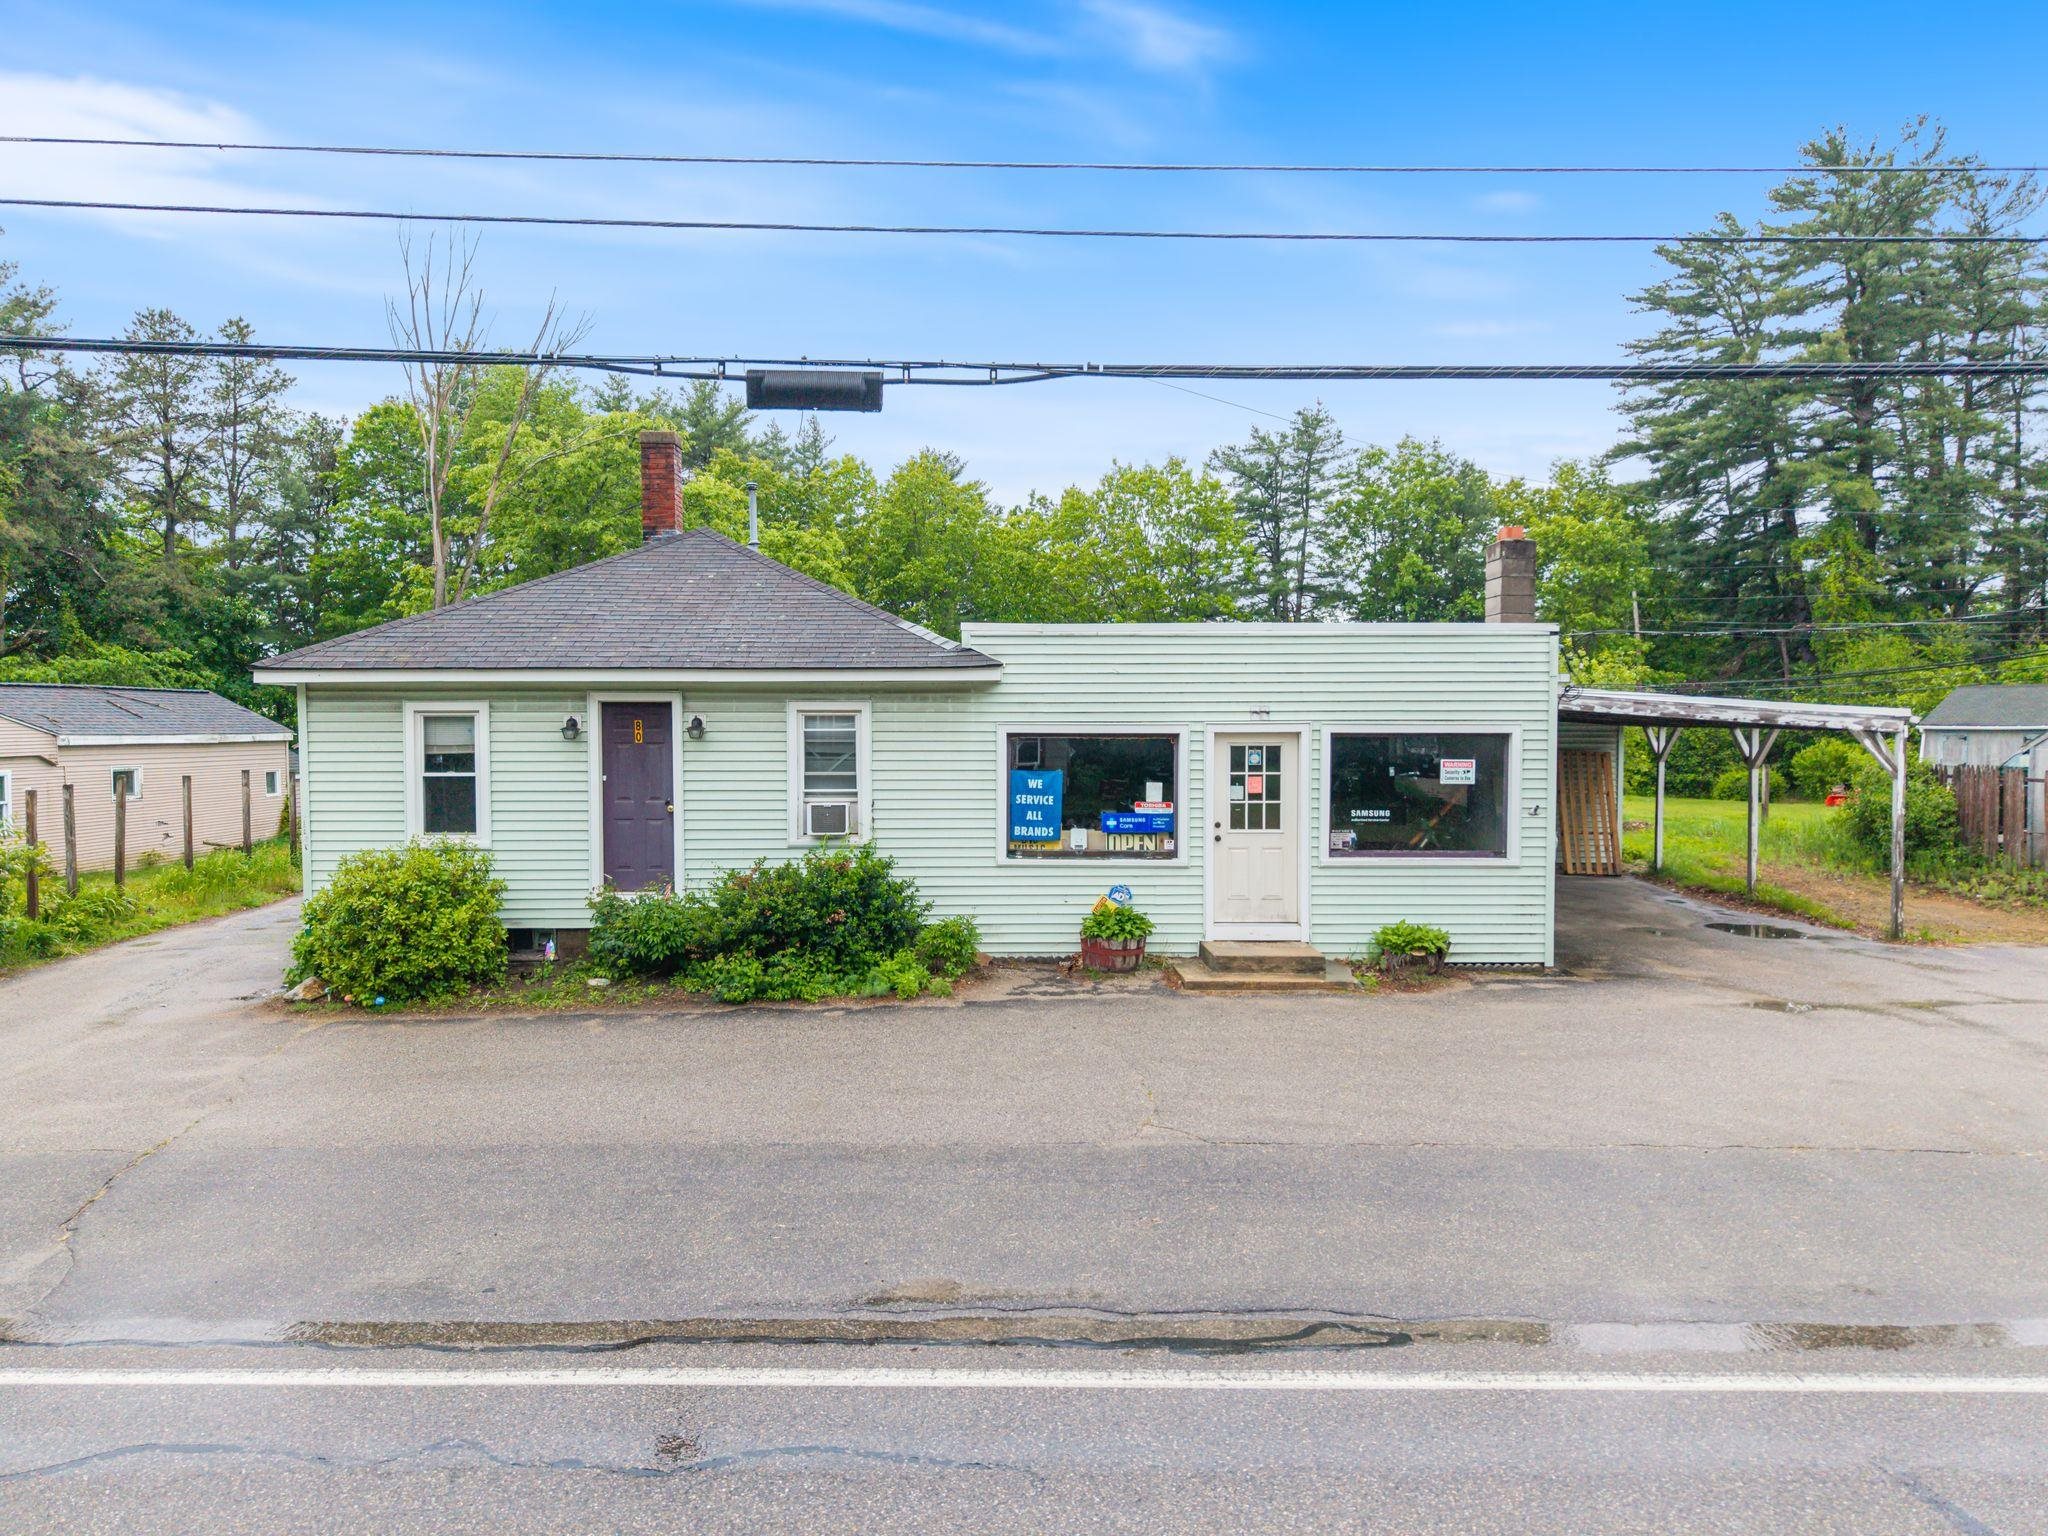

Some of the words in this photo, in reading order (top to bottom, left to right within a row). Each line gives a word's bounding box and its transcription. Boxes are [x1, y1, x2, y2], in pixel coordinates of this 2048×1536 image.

[635, 720, 642, 742] 80
[1028, 779, 1043, 789] WE
[1015, 795, 1054, 805] SERVICE
[1026, 811, 1043, 820] ALL
[1350, 809, 1391, 817] SAMSUNG
[1014, 826, 1054, 837] BRANDS
